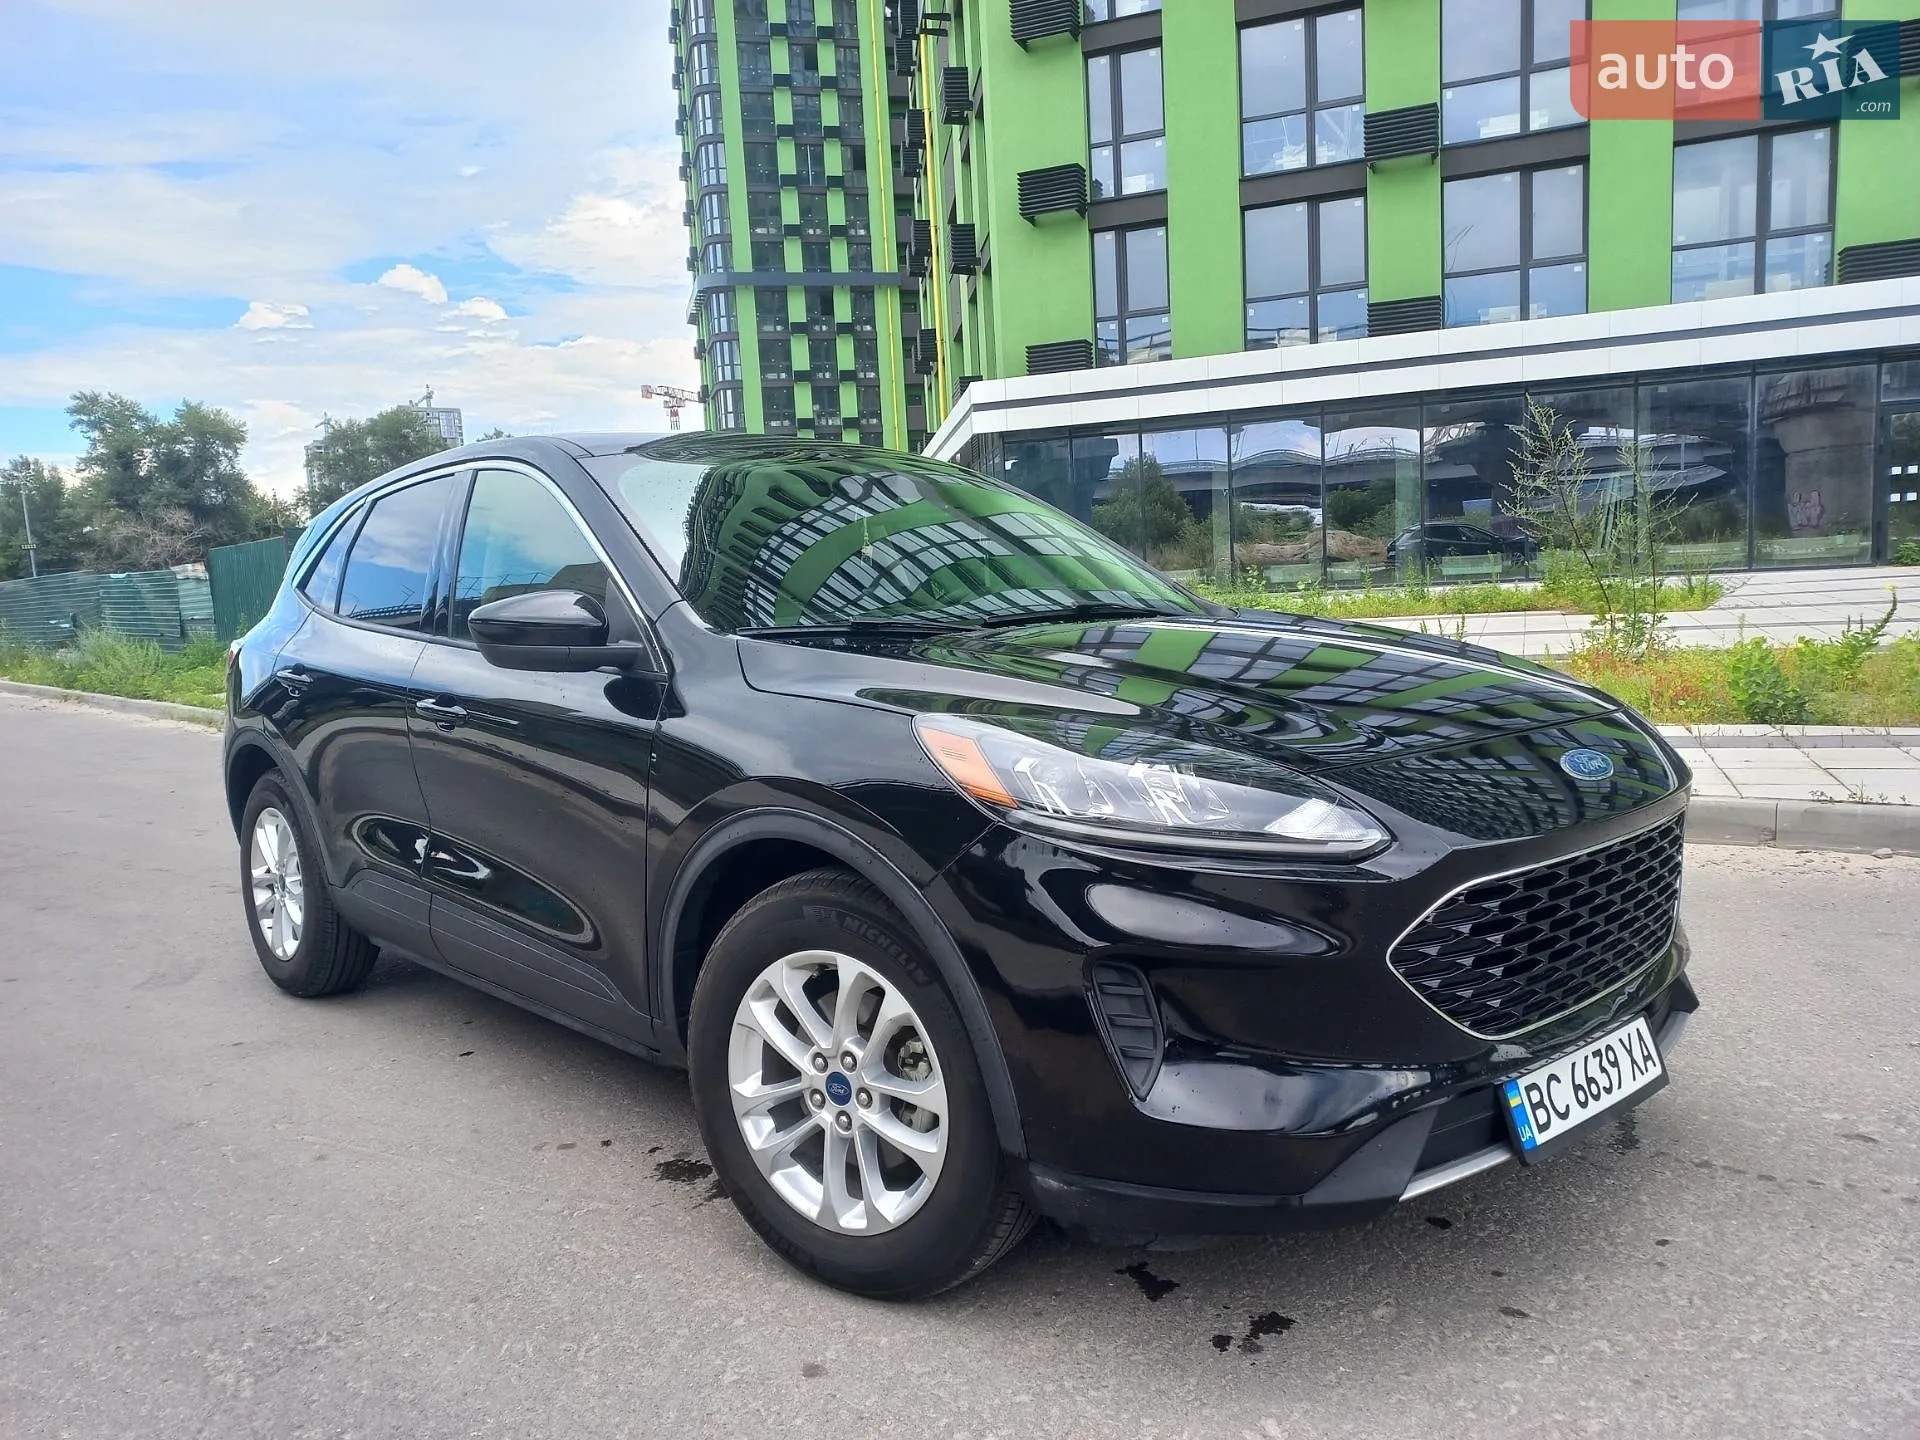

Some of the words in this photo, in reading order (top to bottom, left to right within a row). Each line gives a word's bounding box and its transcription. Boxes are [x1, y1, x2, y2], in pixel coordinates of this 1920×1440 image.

[842, 917, 929, 985] MICHELIN
[1524, 1073, 1570, 1135] BC
[1571, 1043, 1623, 1110] 6639
[1618, 1027, 1657, 1082] XA
[1517, 1127, 1533, 1141] UA
